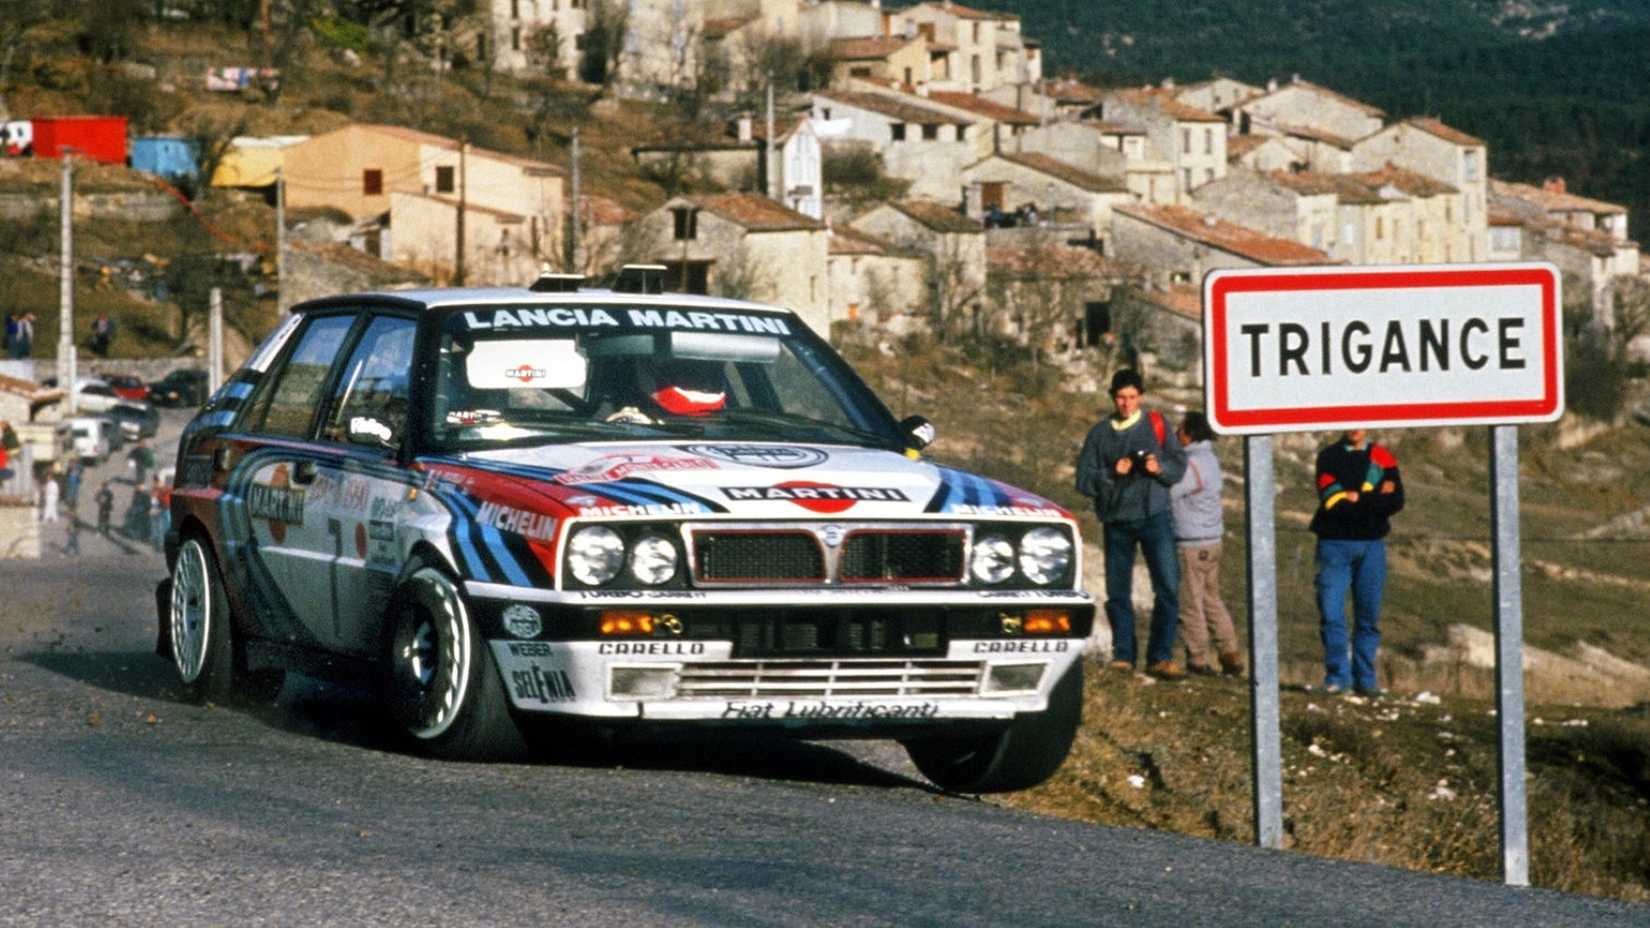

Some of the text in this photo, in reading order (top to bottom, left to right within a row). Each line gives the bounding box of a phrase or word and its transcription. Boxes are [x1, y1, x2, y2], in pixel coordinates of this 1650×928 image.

[464, 308, 792, 335] LANCIA MARTINI
[1241, 317, 1526, 377] TRIGANCE
[506, 369, 546, 378] MARTINI
[731, 487, 905, 500] MARTINI
[476, 501, 558, 541] MICHELIN
[508, 643, 553, 656] WEBER
[598, 642, 705, 656] CARELLO
[973, 641, 1070, 654] CARELLO
[721, 701, 773, 718] Fiat
